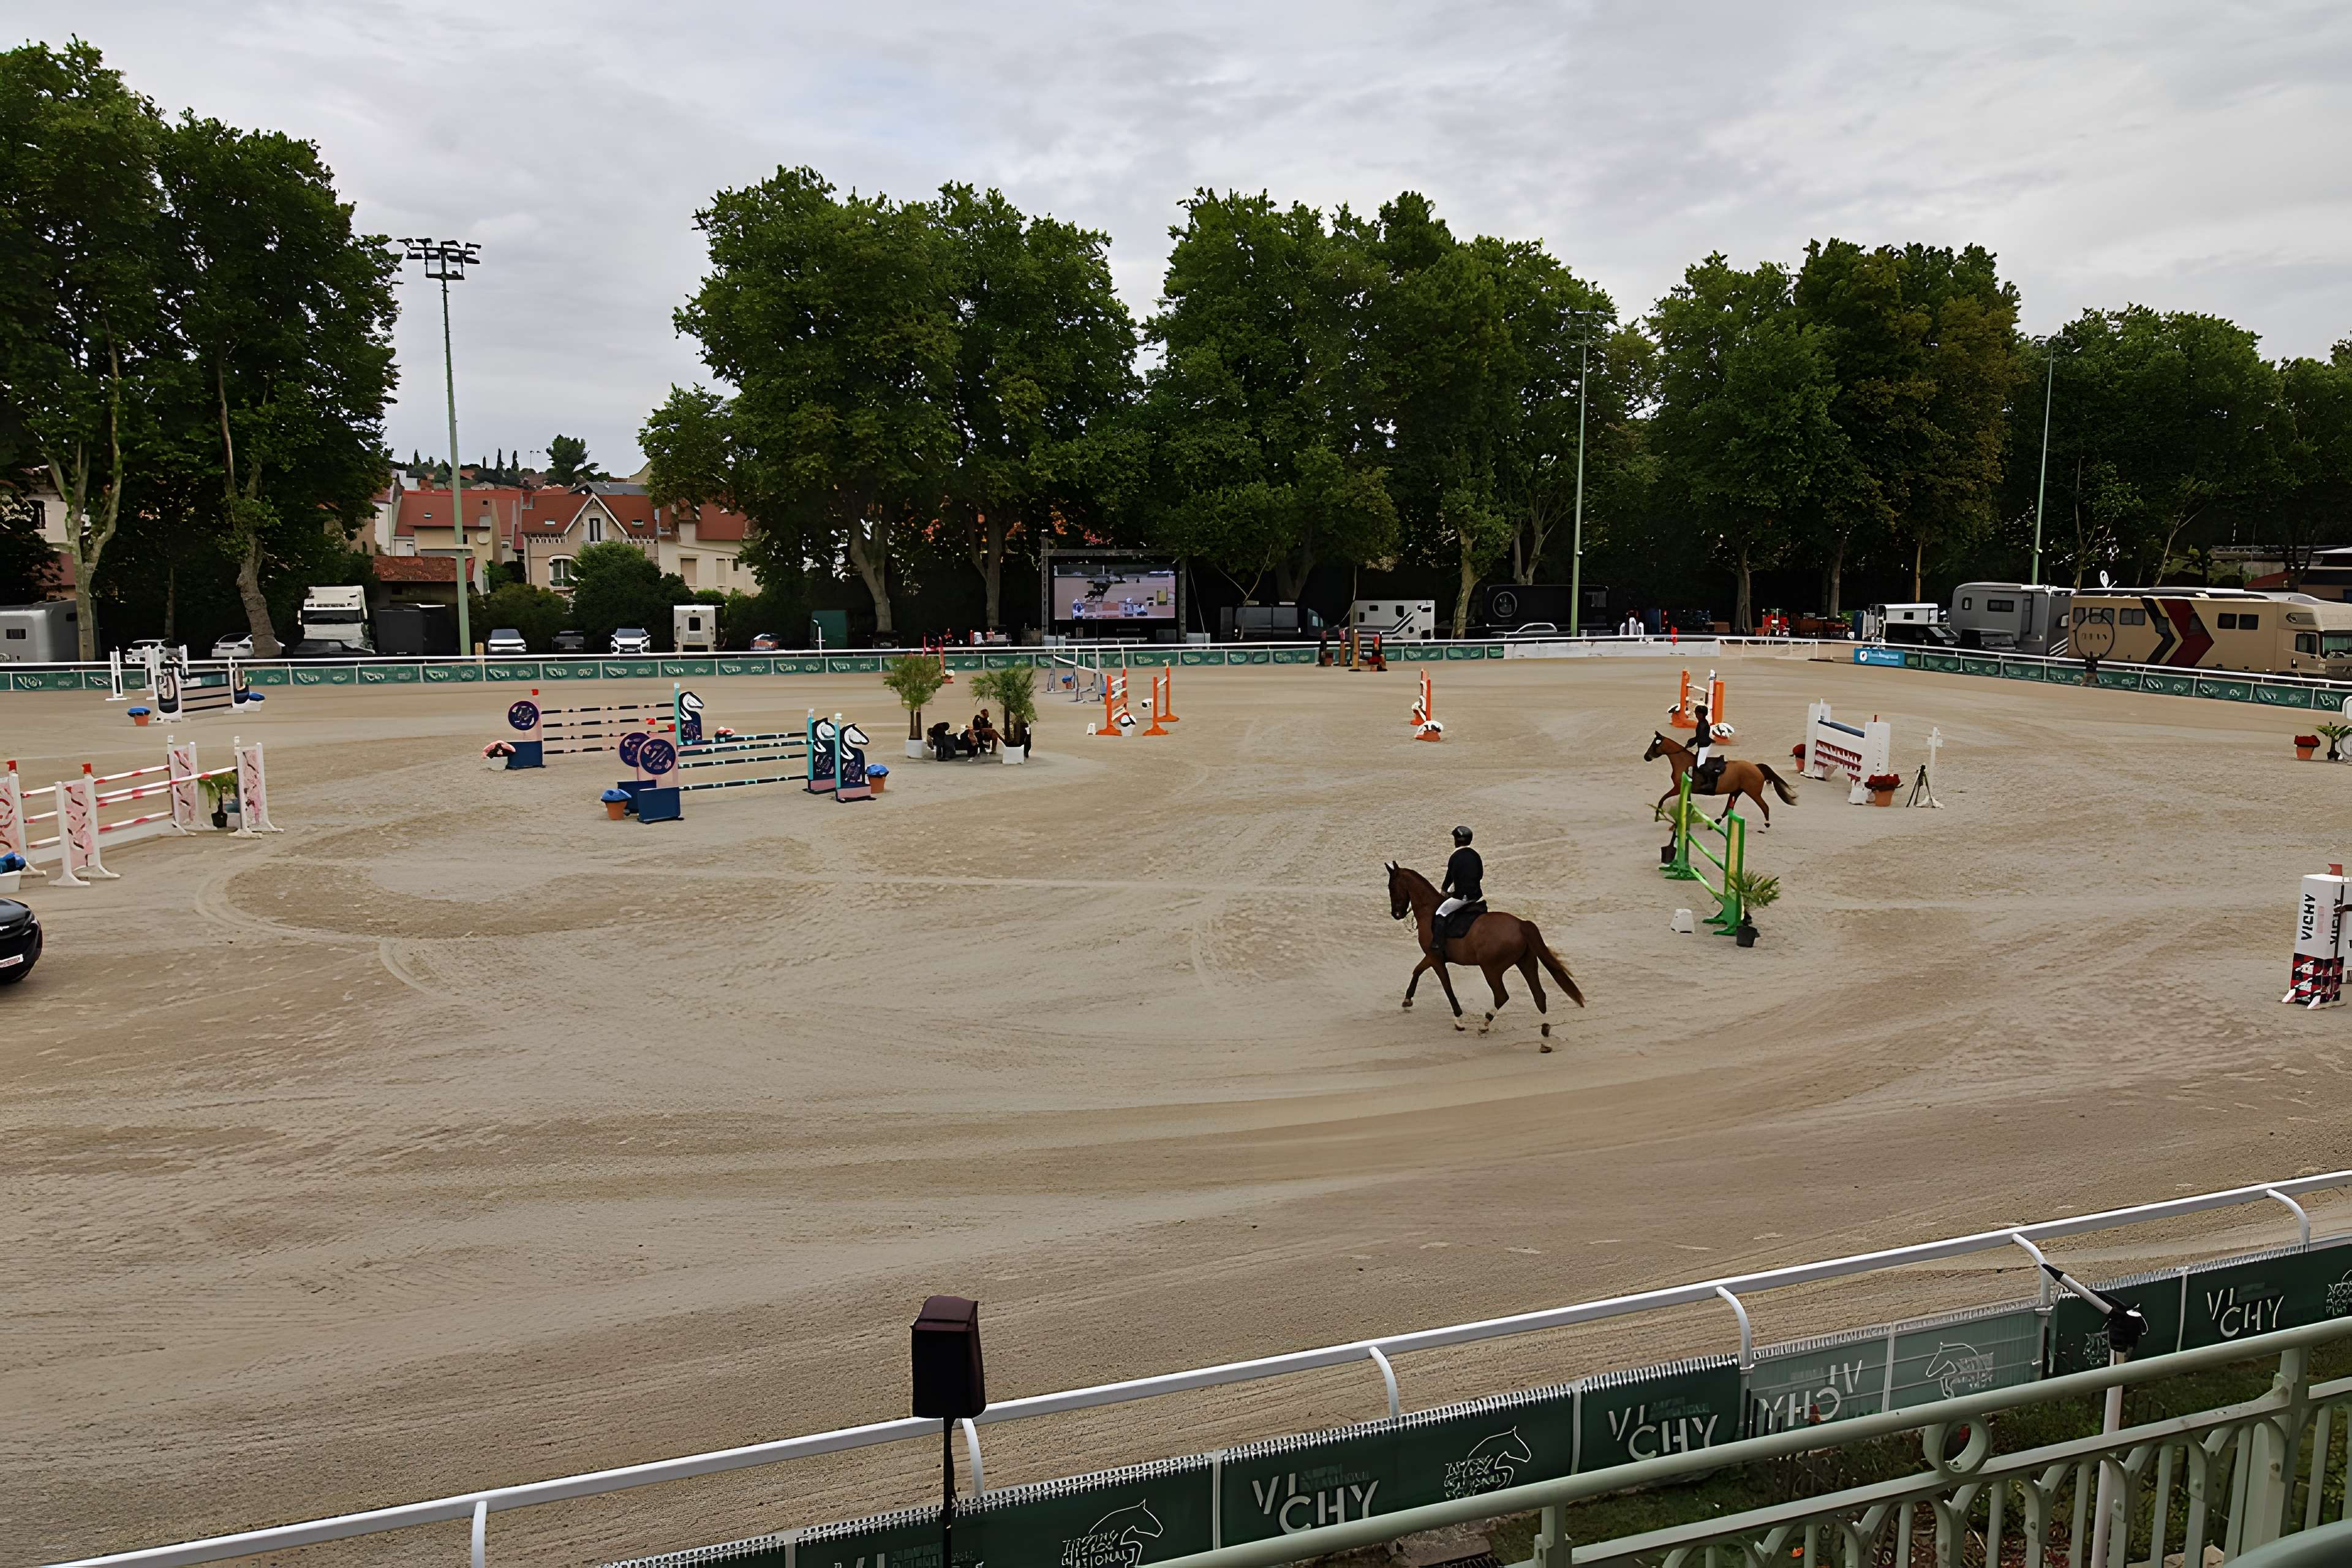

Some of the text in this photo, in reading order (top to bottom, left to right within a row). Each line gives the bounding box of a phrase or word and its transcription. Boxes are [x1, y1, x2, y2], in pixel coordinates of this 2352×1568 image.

[2301, 894, 2315, 940] VICHY
[2207, 1287, 2285, 1338] VICHY
[1608, 1404, 1719, 1461] VICHY
[1252, 1472, 1379, 1535] VICHY
